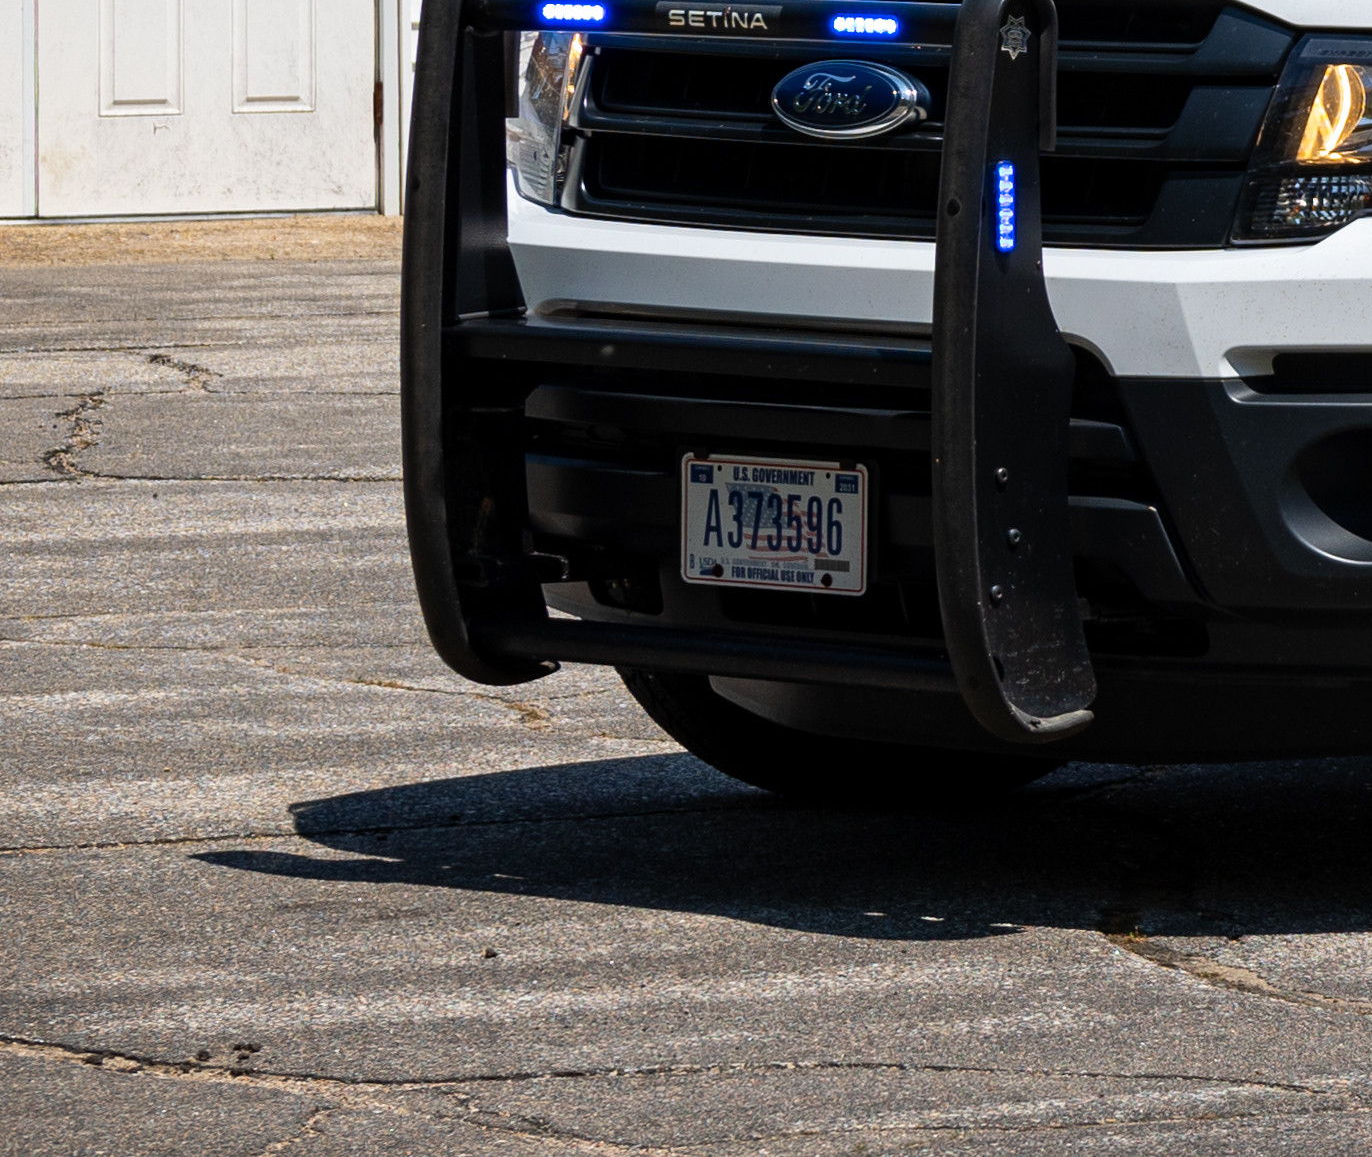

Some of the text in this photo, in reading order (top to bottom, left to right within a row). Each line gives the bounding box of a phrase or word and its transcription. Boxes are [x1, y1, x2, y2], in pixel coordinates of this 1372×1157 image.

[668, 6, 768, 30] SETINA
[792, 71, 873, 115] Ford
[732, 466, 750, 482] U.S.
[752, 467, 816, 487] GOVERNMENT
[702, 488, 843, 556] A373596
[731, 565, 815, 584] FOR OFFICIAL USE ONLY
